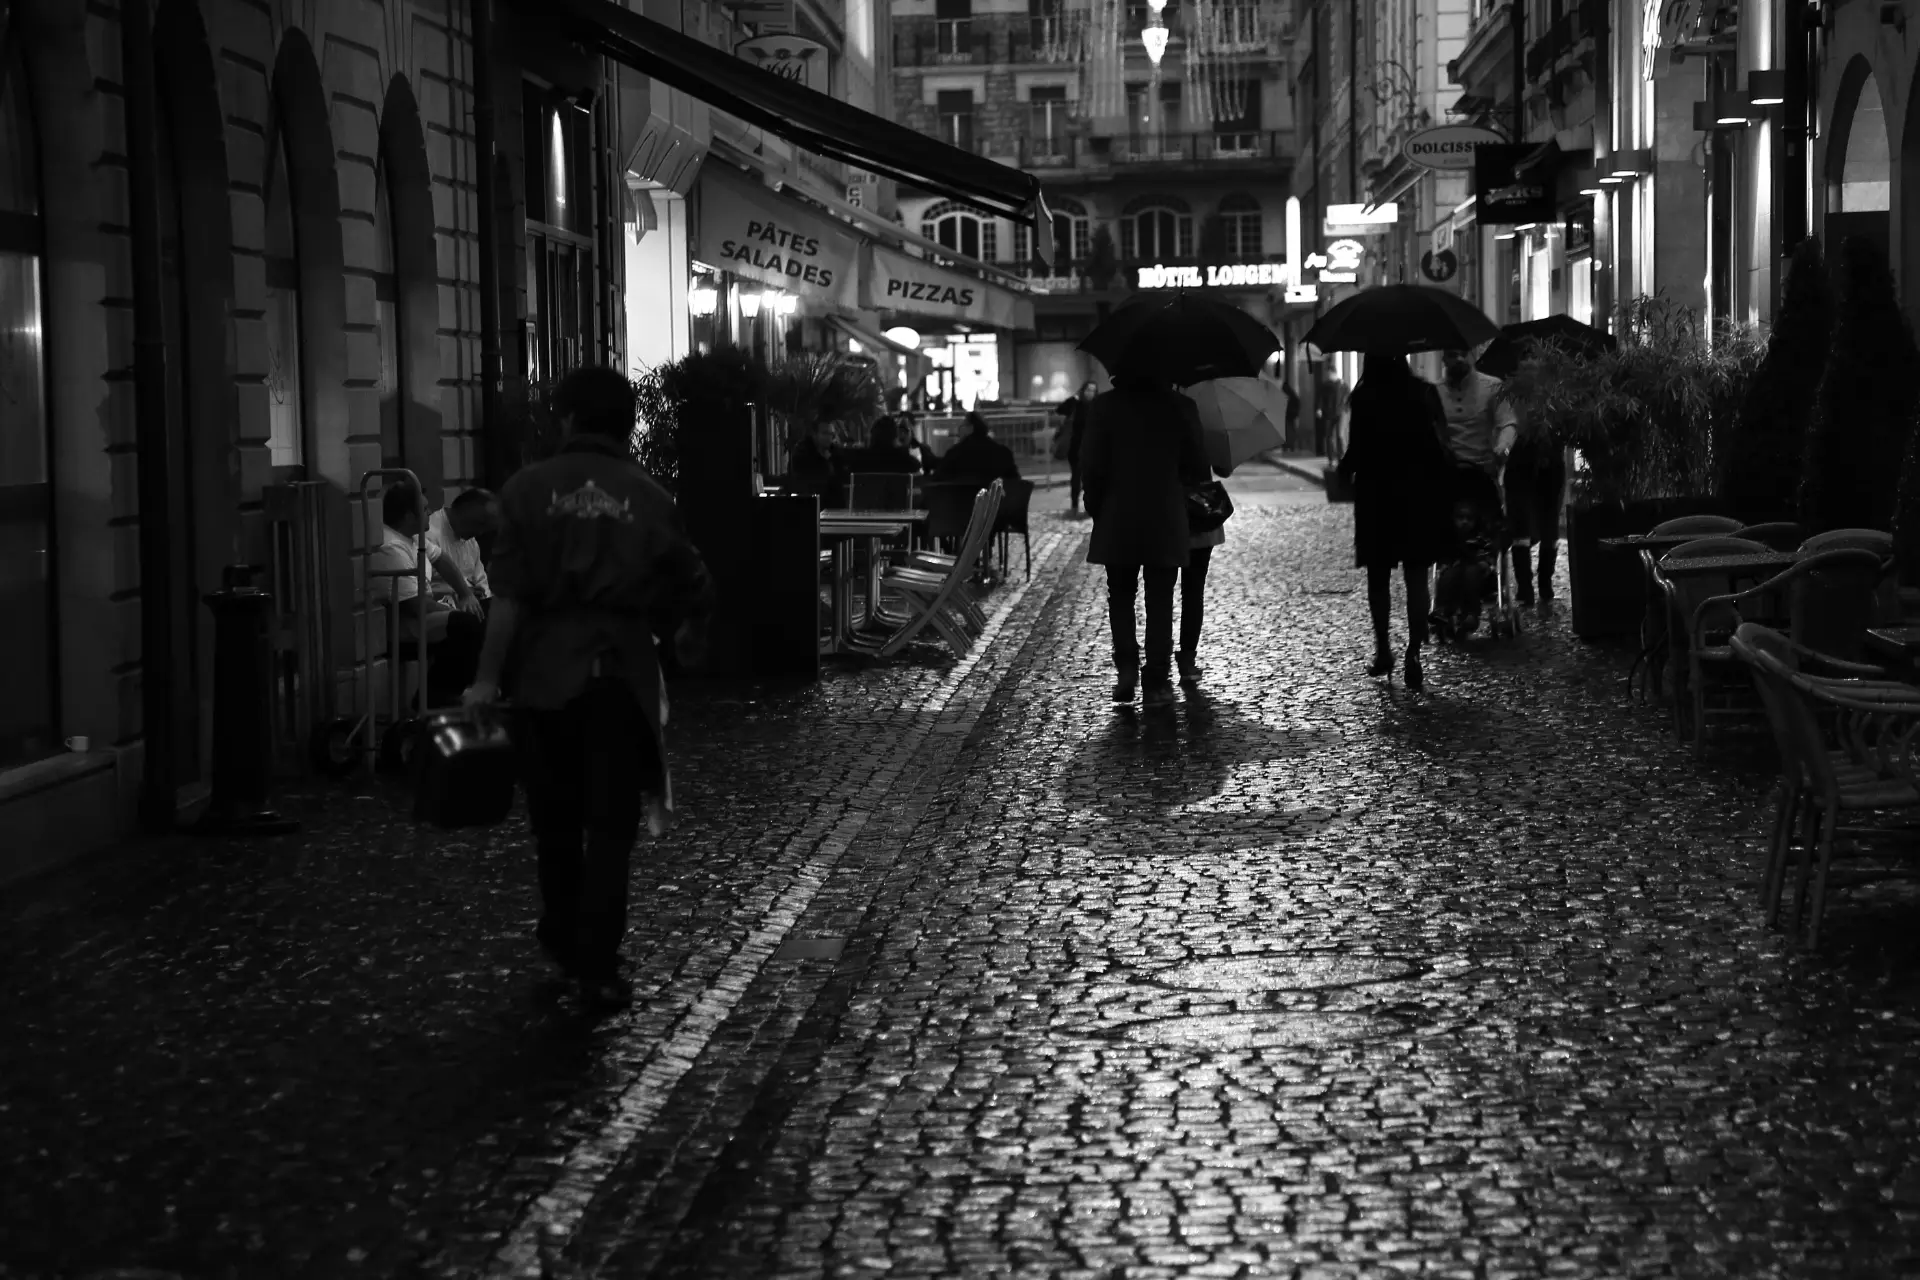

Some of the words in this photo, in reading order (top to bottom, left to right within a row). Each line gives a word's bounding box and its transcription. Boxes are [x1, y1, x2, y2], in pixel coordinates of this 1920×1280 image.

[1412, 140, 1498, 154] DOLCISS
[747, 219, 819, 256] PÂTES
[720, 240, 832, 287] SALADES
[888, 278, 974, 306] PIZZAS
